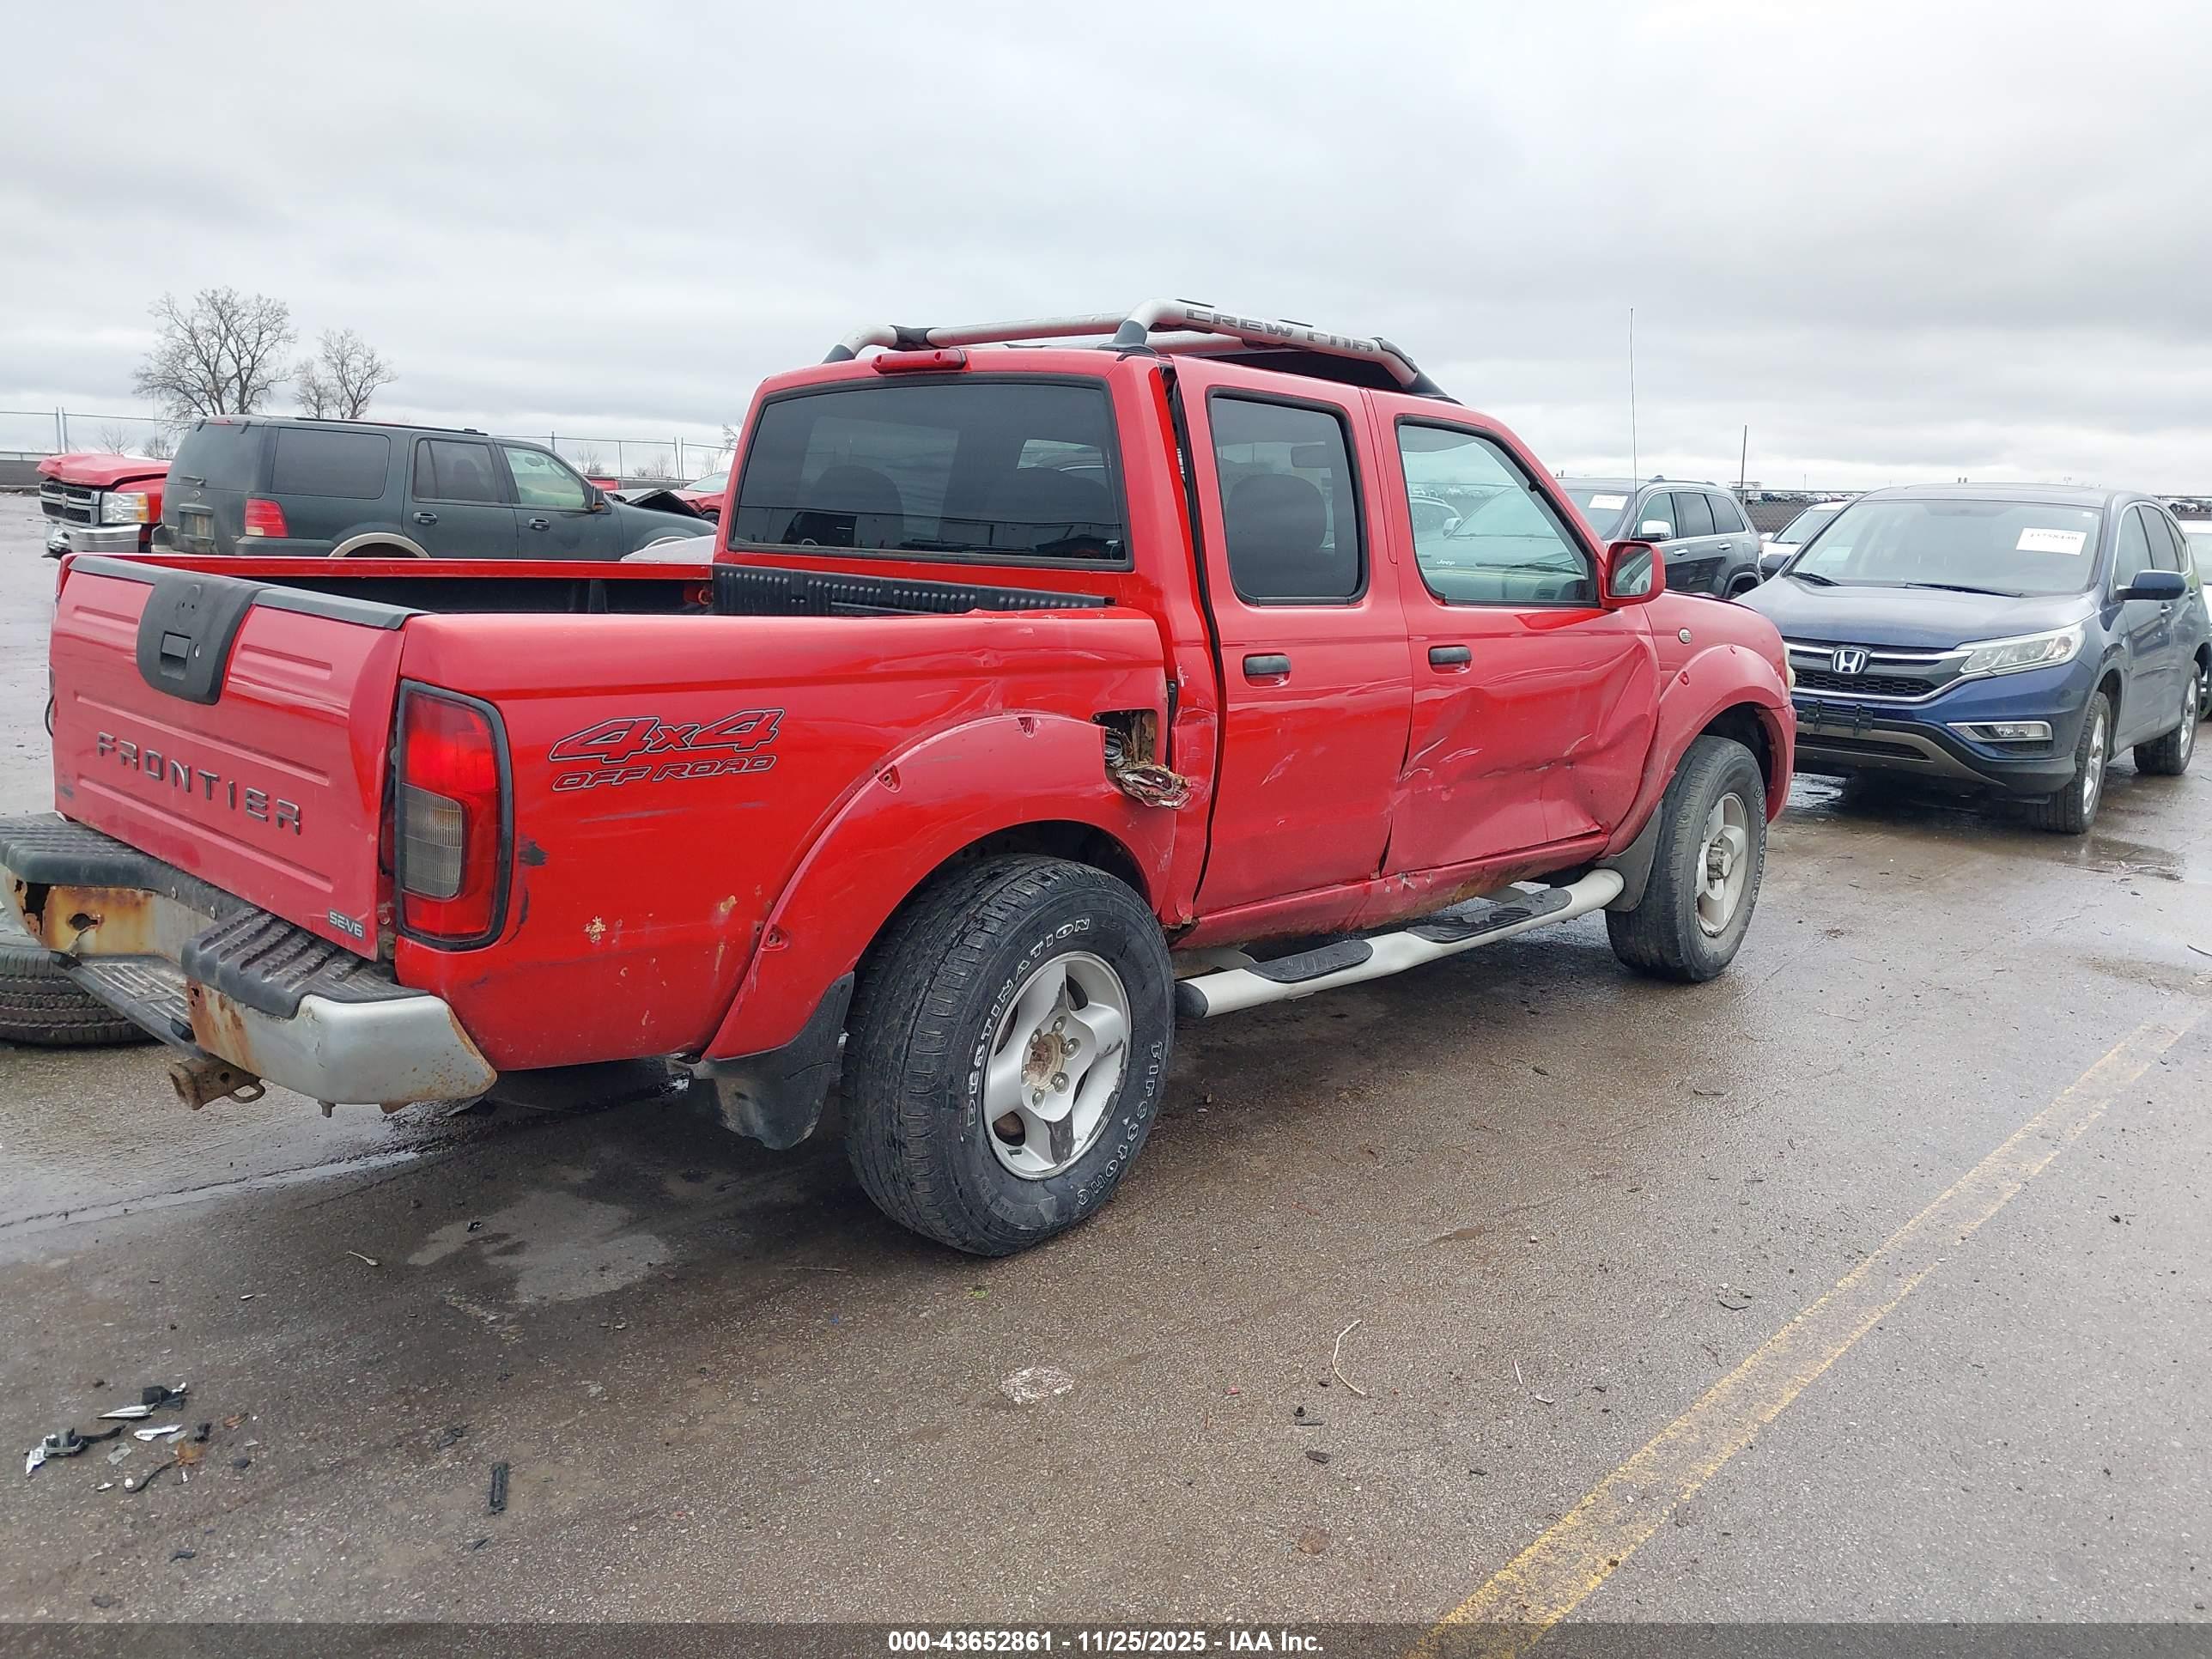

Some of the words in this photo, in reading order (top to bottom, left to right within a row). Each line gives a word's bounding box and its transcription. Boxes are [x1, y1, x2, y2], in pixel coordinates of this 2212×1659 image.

[1186, 308, 1294, 337] CREW
[548, 707, 785, 764] 4x4
[97, 731, 301, 835] FRONTIER
[551, 766, 652, 792] OFF
[651, 755, 777, 782] ROAD
[967, 918, 1091, 1127] DESTINATION
